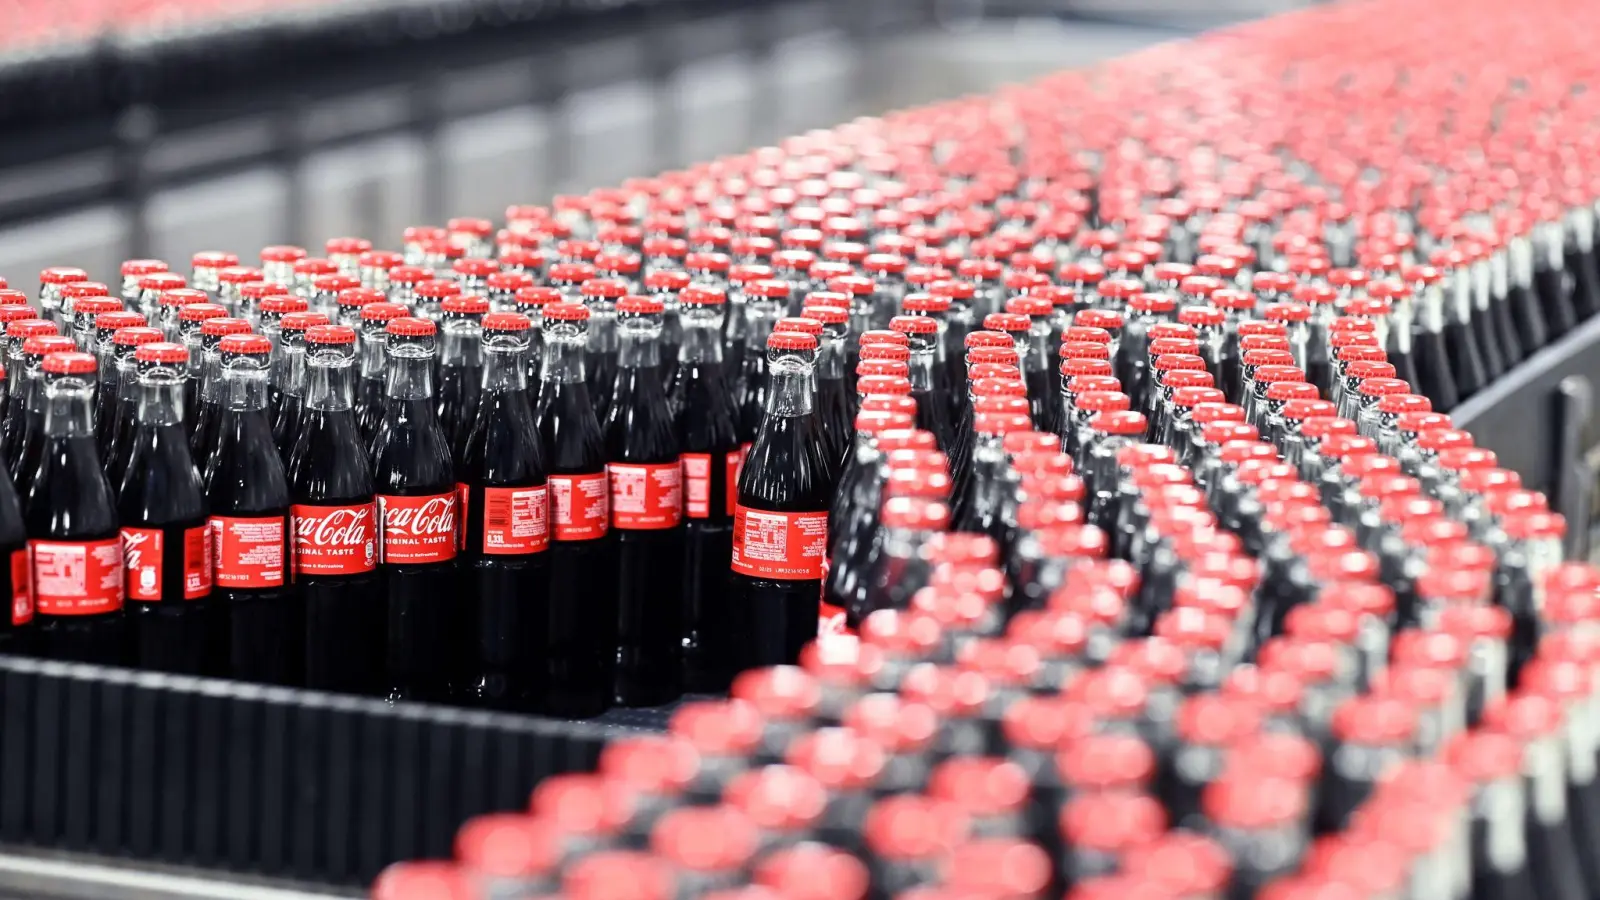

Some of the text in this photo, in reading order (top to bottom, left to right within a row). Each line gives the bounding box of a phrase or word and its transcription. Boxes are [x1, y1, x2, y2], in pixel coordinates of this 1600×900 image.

[423, 536, 447, 544] TASTE
[487, 534, 505, 544] 0,33L
[296, 547, 355, 556] GINAL TASTE
